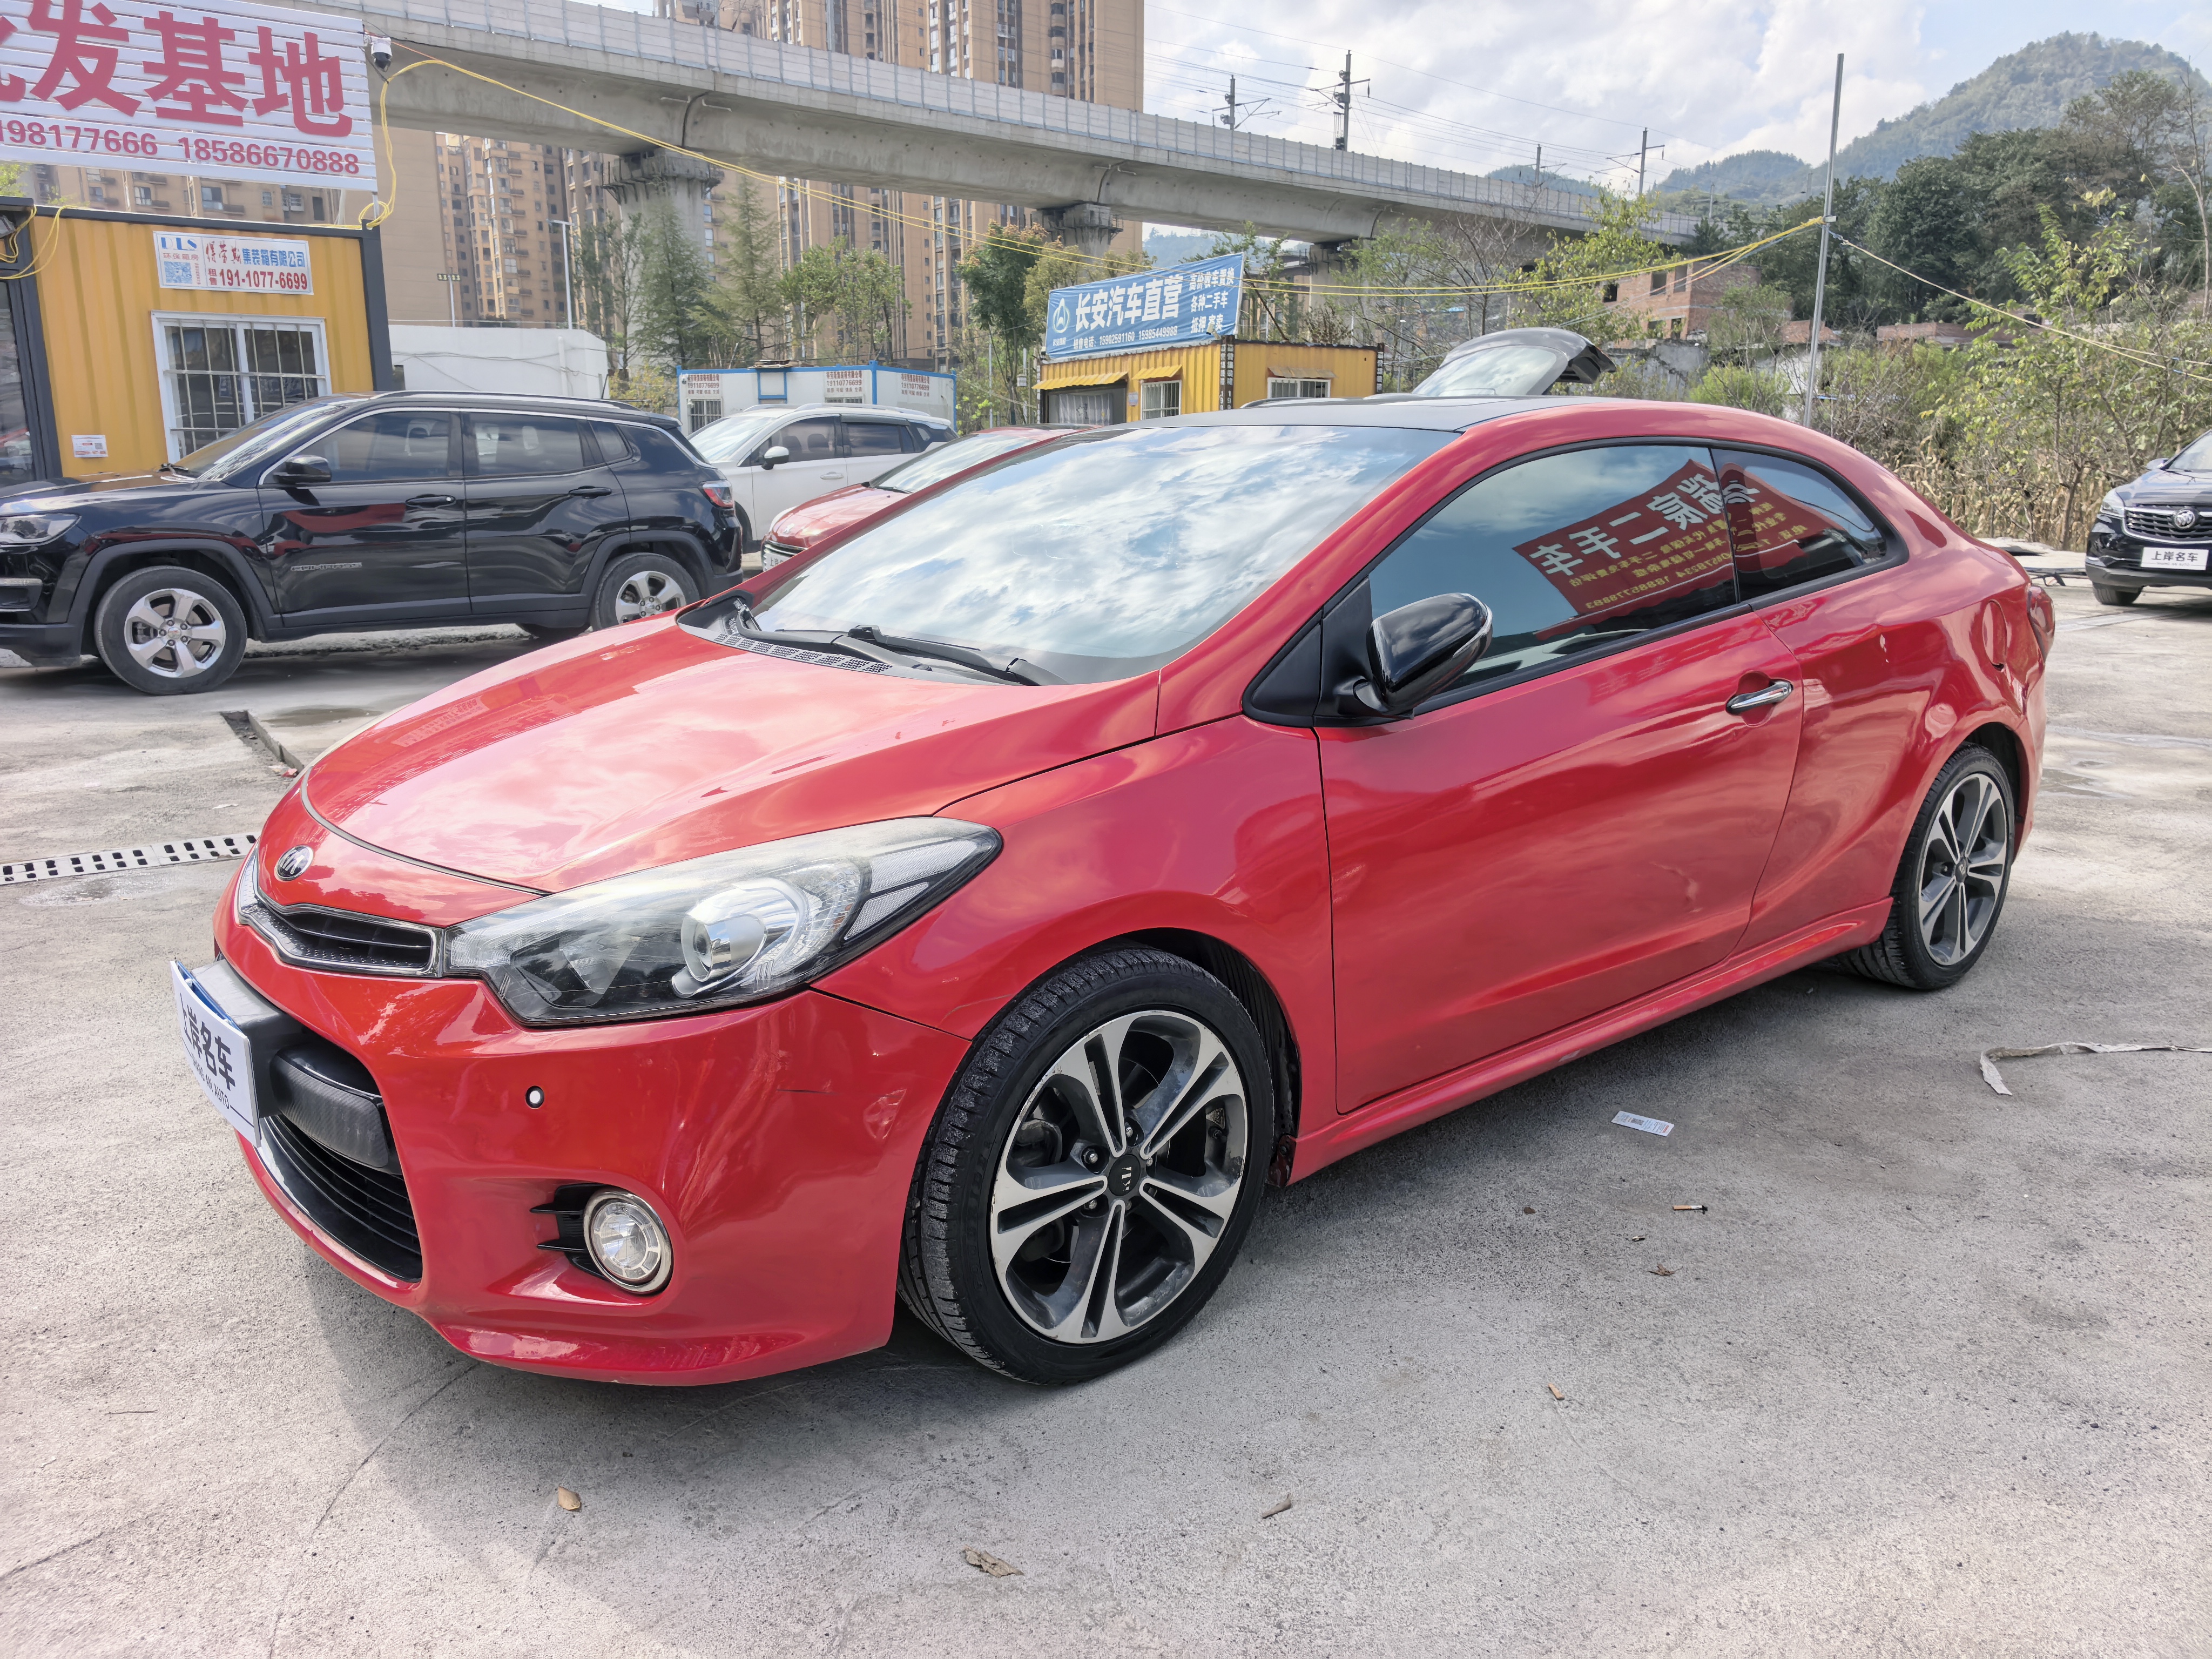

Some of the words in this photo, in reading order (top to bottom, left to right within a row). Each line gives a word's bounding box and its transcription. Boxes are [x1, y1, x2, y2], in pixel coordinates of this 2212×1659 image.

[178, 137, 360, 175] 18586670888
[219, 268, 307, 290] 191-1077-6699
[1076, 274, 1183, 332] 长安汽车直营
[1191, 291, 1228, 312] 各种二手车
[1100, 332, 1135, 345] 15902591160
[2151, 551, 2198, 562] 上岸名车
[180, 992, 235, 1091] 上岸名车
[206, 1073, 213, 1092] AN
[214, 1083, 230, 1109] AUTO
